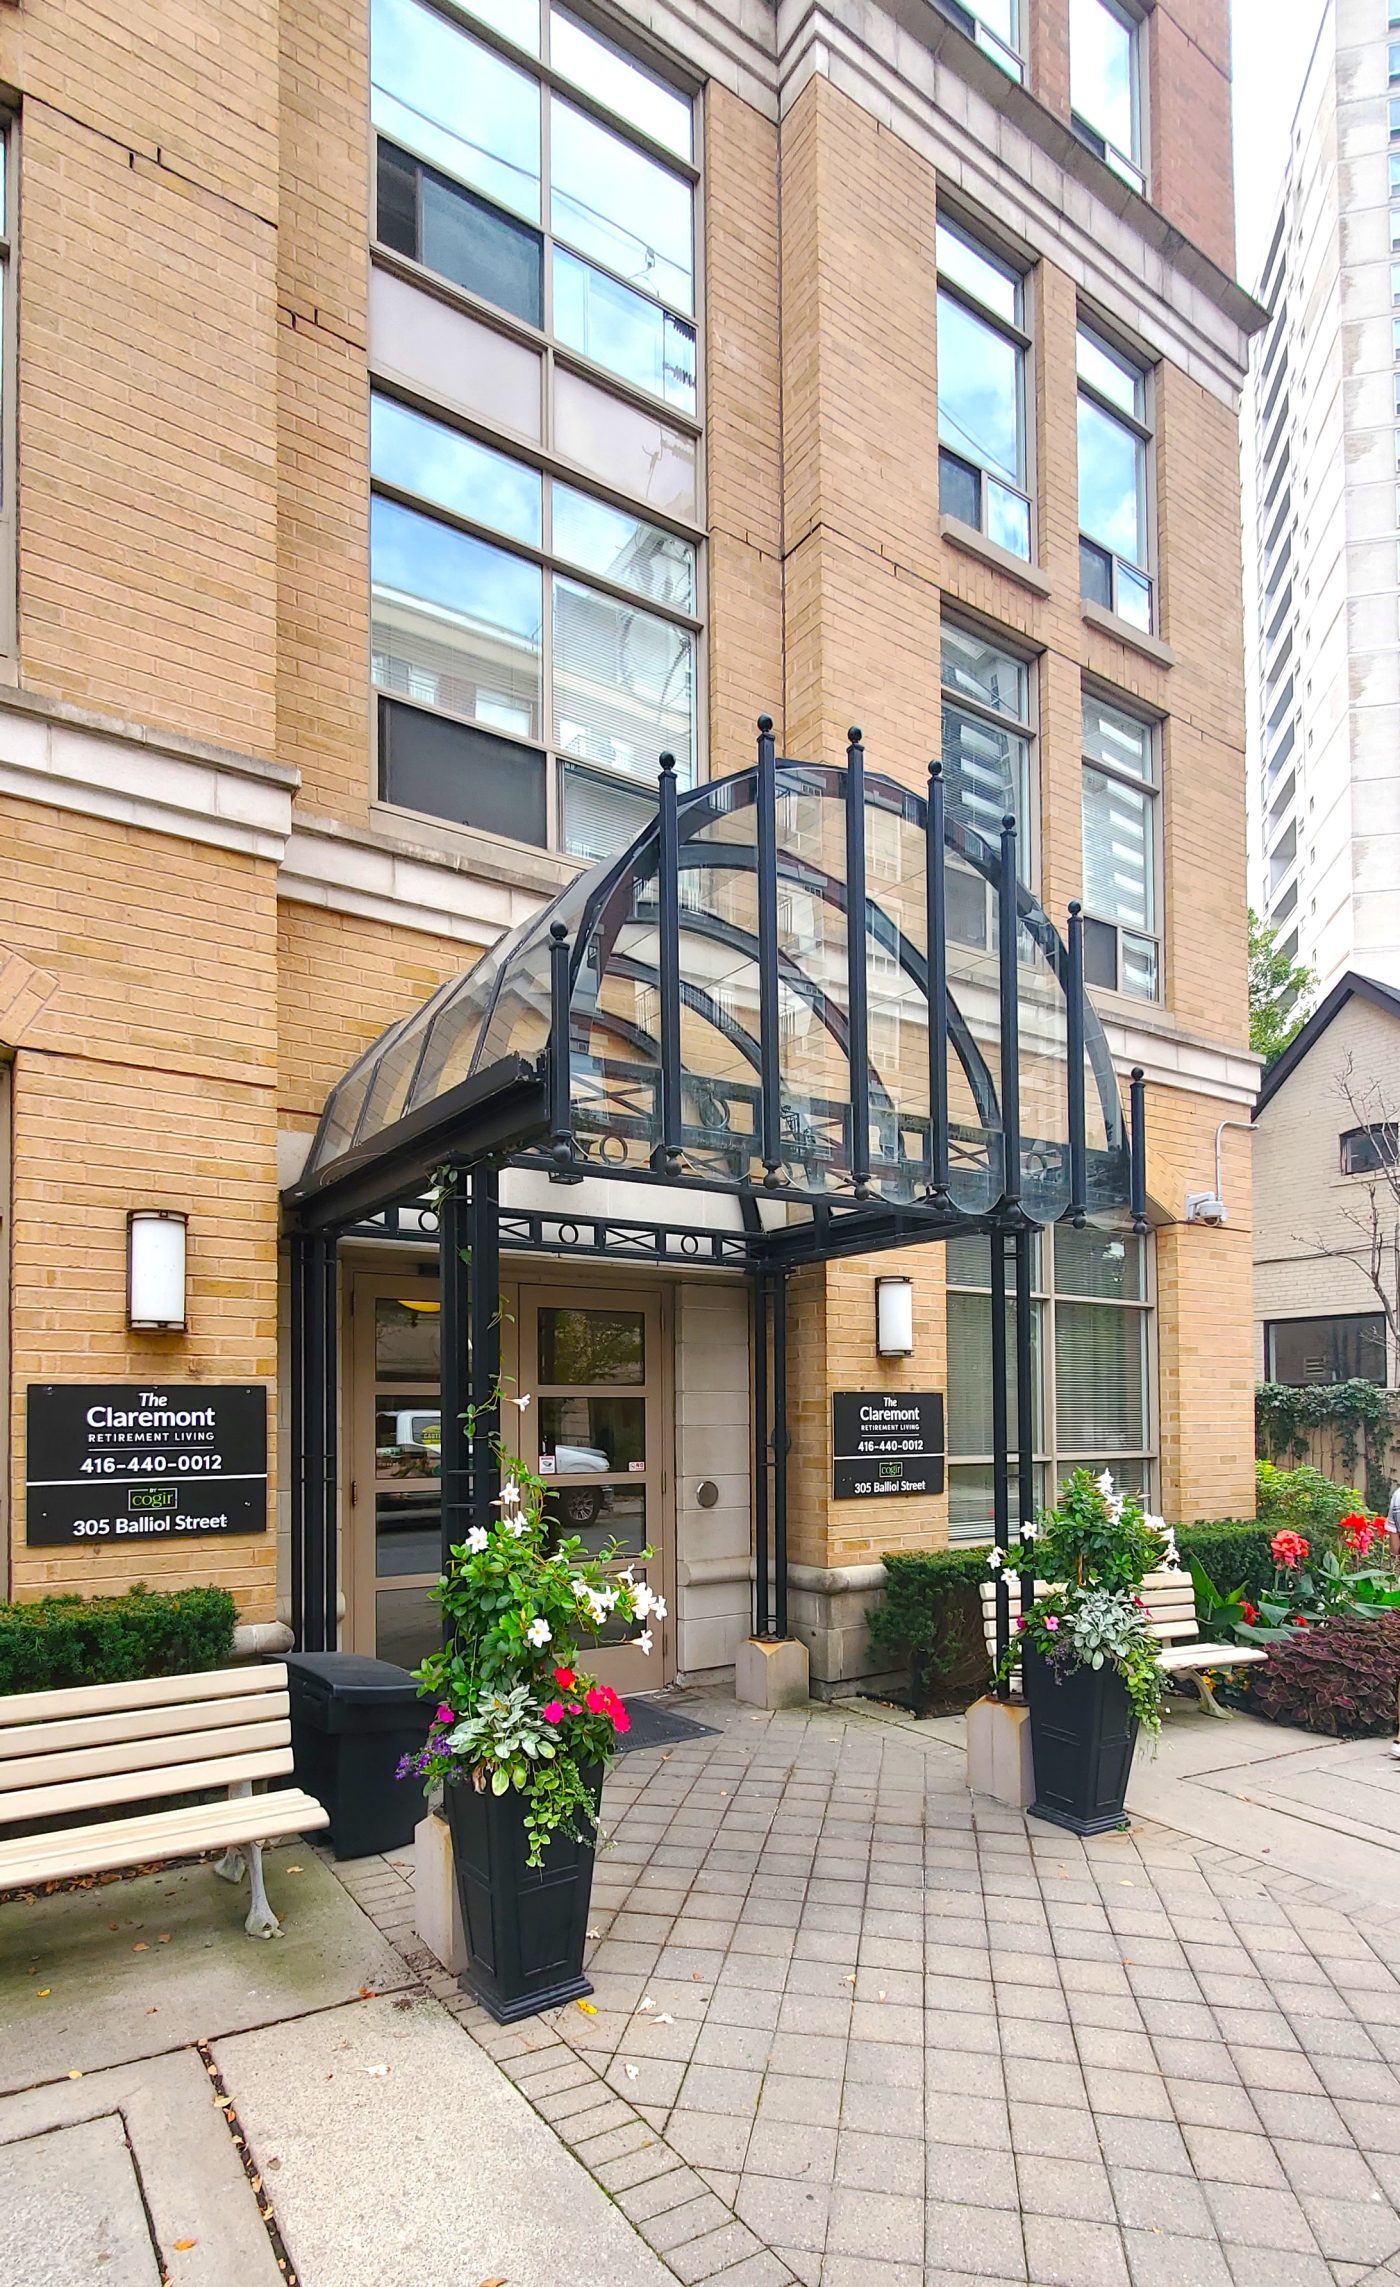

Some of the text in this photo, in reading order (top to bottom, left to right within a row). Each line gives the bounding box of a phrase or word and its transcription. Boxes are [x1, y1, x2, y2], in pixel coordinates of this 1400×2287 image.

[139, 1393, 168, 1407] The
[883, 1397, 897, 1407] The
[87, 1407, 216, 1428] Claremont
[860, 1407, 920, 1421] Claremont
[88, 1432, 215, 1443] RETIREMENT LIVING
[858, 1440, 924, 1451] 416-440-0012
[80, 1455, 222, 1473] 416-440-0012
[854, 1480, 926, 1494] 305 Balliol Street
[132, 1493, 174, 1508] cogir
[73, 1514, 227, 1536] 305 Balliol Street
